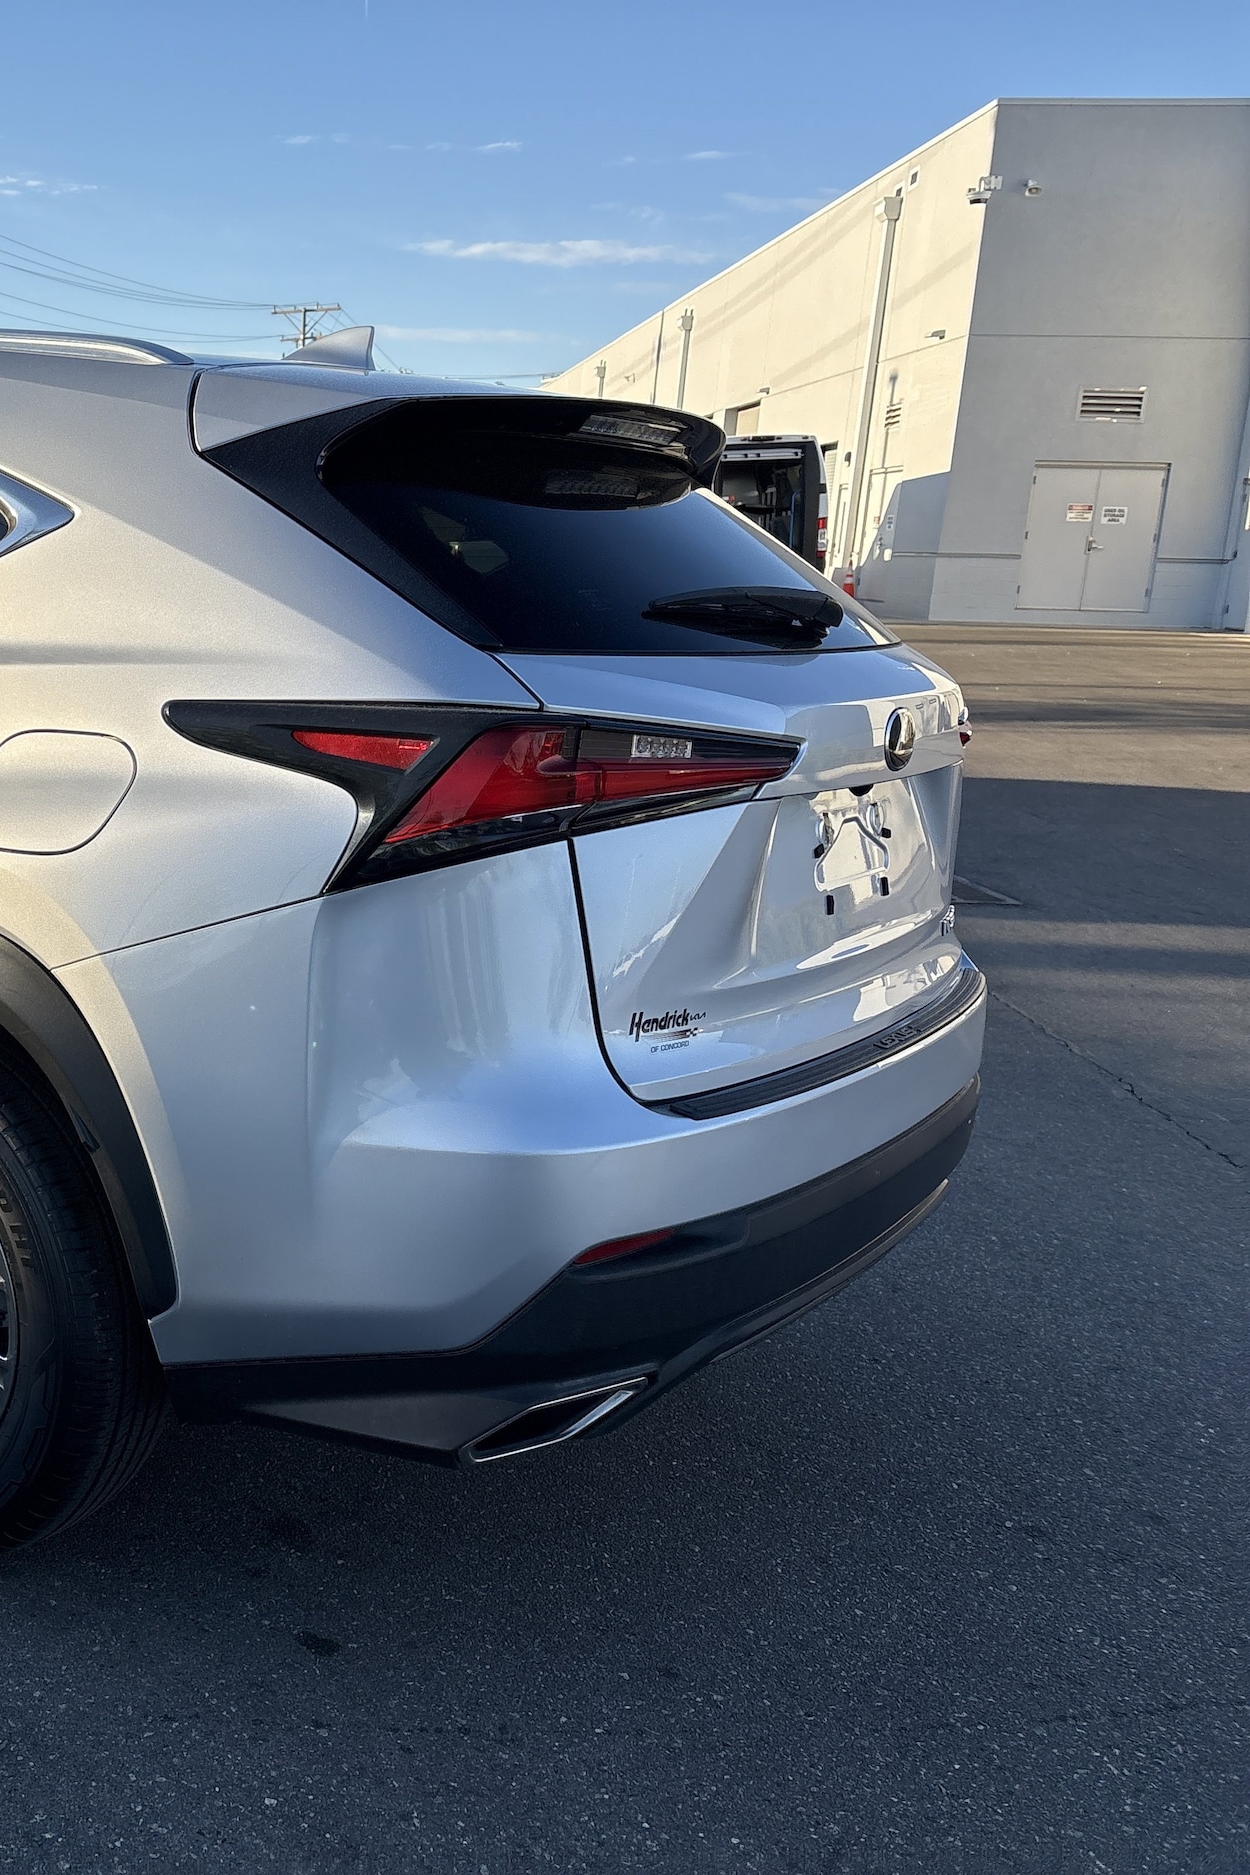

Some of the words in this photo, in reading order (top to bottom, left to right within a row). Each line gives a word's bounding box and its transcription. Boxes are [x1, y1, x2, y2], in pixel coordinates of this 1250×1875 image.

[628, 1008, 690, 1043] Hendrick
[650, 1045, 660, 1053] OF
[660, 1040, 690, 1052] CONCORD
